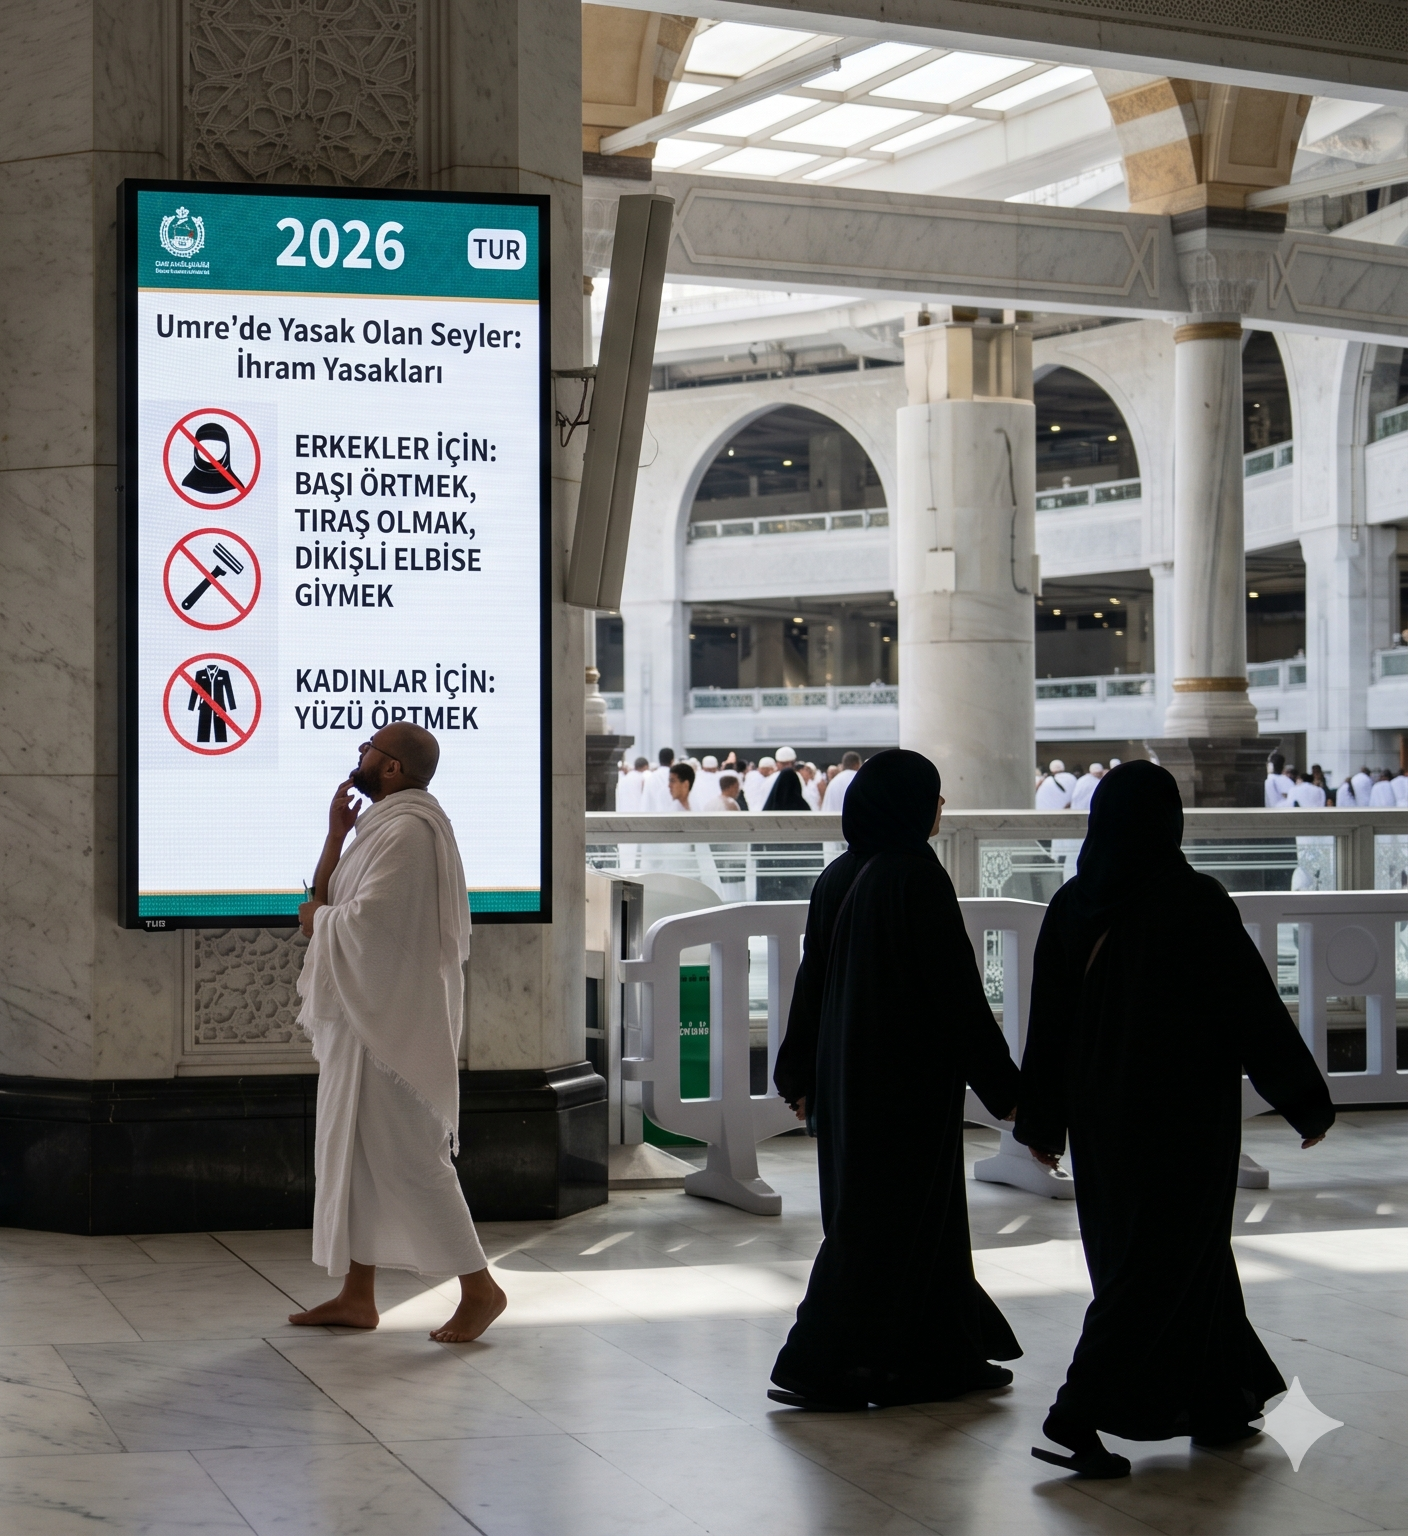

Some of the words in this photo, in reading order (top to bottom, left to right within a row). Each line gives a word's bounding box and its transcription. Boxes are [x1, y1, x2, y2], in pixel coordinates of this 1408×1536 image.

[276, 217, 405, 271] 2026
[473, 238, 520, 261] TUR
[278, 317, 356, 344] Yasak
[362, 319, 423, 346] Olan
[430, 322, 521, 354] Seyler:
[237, 347, 316, 381] İhram
[322, 356, 442, 384] Yasakları
[295, 434, 430, 461] ERKEKLER
[437, 431, 497, 468] İÇİN:
[295, 471, 352, 503] BAŞI
[360, 467, 476, 504] ÖRTMEK,
[294, 508, 370, 540] TIRAŞ
[377, 509, 476, 540] OLMAK,
[295, 539, 387, 577] DİKİŞLİ
[394, 541, 482, 572] ELBİSE
[295, 576, 394, 608] GİYMEK
[296, 668, 428, 693] KADINLAR
[435, 662, 495, 700] İÇİN:
[294, 699, 363, 730] YÜZÜ
[371, 699, 479, 730] ÖRTMEK
